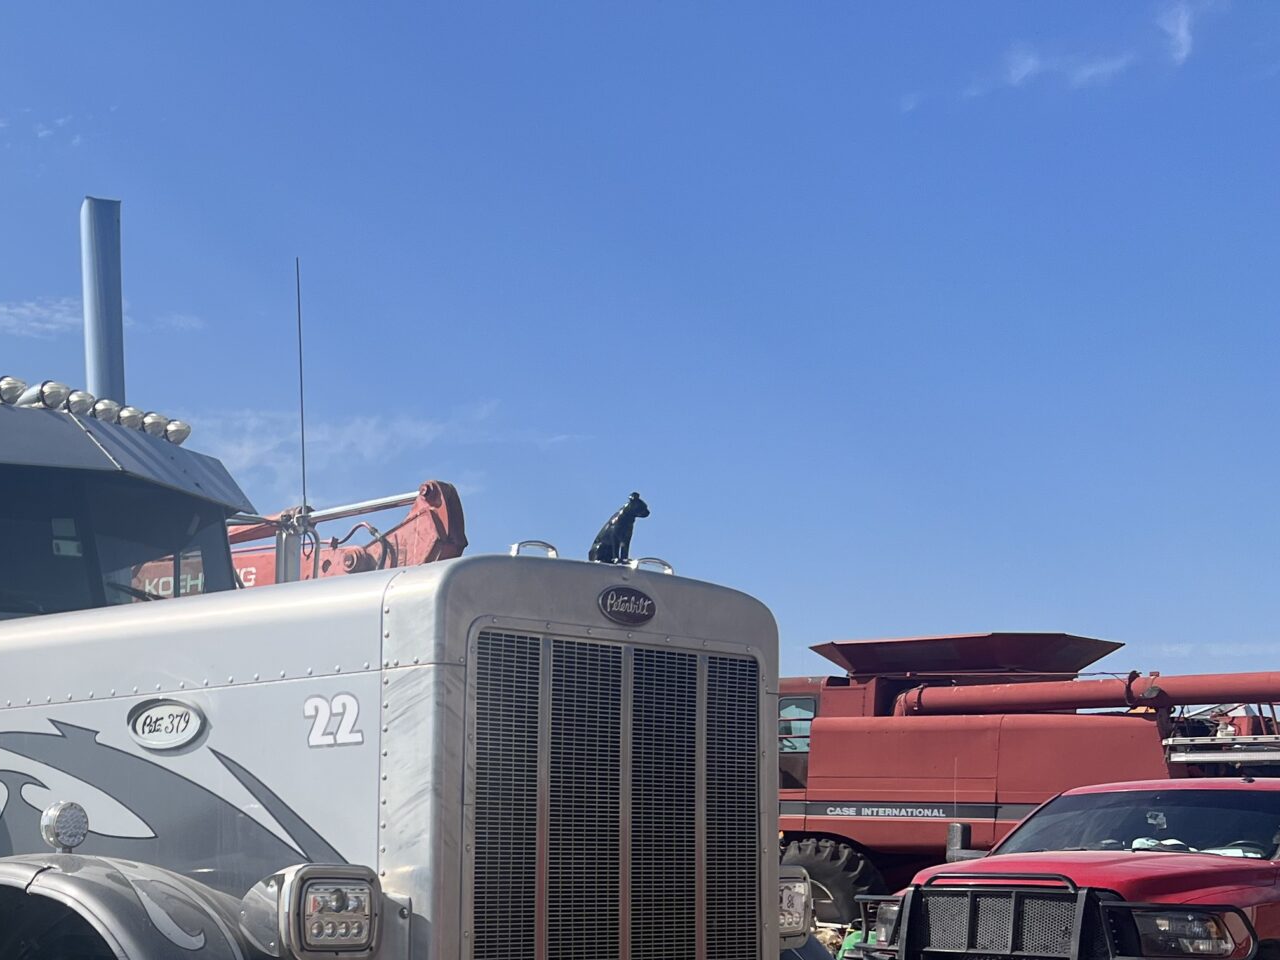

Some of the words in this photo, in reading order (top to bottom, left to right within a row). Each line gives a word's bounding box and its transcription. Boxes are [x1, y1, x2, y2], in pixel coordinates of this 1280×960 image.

[607, 591, 652, 615] Peterbilt
[164, 711, 192, 735] 379
[303, 692, 364, 749] 22
[826, 807, 857, 816] CASE
[861, 807, 946, 817] INTERNATIONAL
